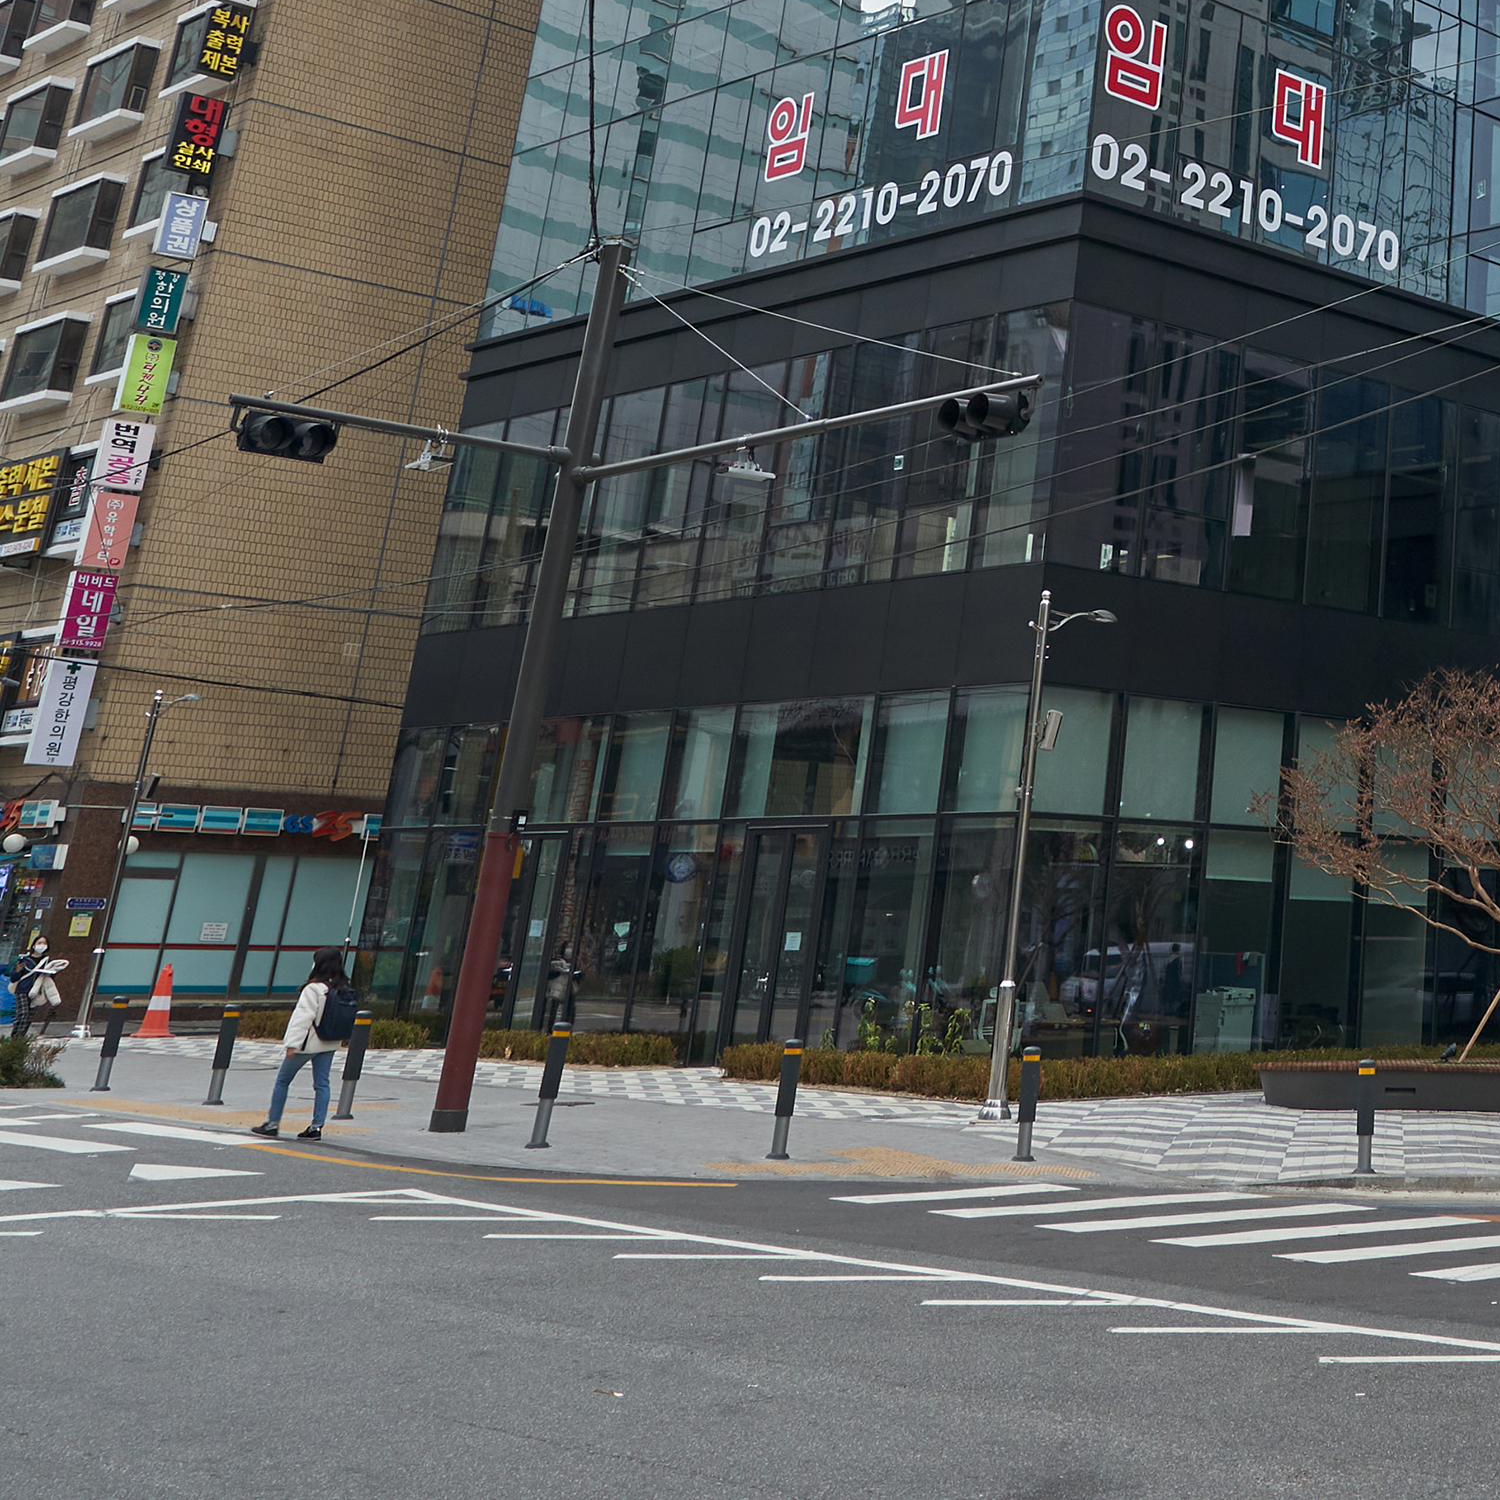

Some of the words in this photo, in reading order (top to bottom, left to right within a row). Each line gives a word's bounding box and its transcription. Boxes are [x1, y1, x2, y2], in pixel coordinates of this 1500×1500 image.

[211, 8, 249, 34] 복사
[206, 29, 244, 54] 출력
[200, 50, 237, 75] 제본
[185, 94, 224, 146] 대형
[172, 154, 211, 174] 인쇄
[177, 141, 215, 161] 실사
[749, 150, 1013, 259] 02-2210-2070
[1090, 132, 1400, 271] 02-2210-2070
[166, 199, 200, 254] 상품권
[146, 281, 175, 329] 한의원
[111, 422, 140, 453] 번역
[77, 574, 115, 588] 비비드
[76, 590, 104, 638] 네일
[46, 675, 78, 757] 평강한의원
[284, 810, 362, 841] GS25
